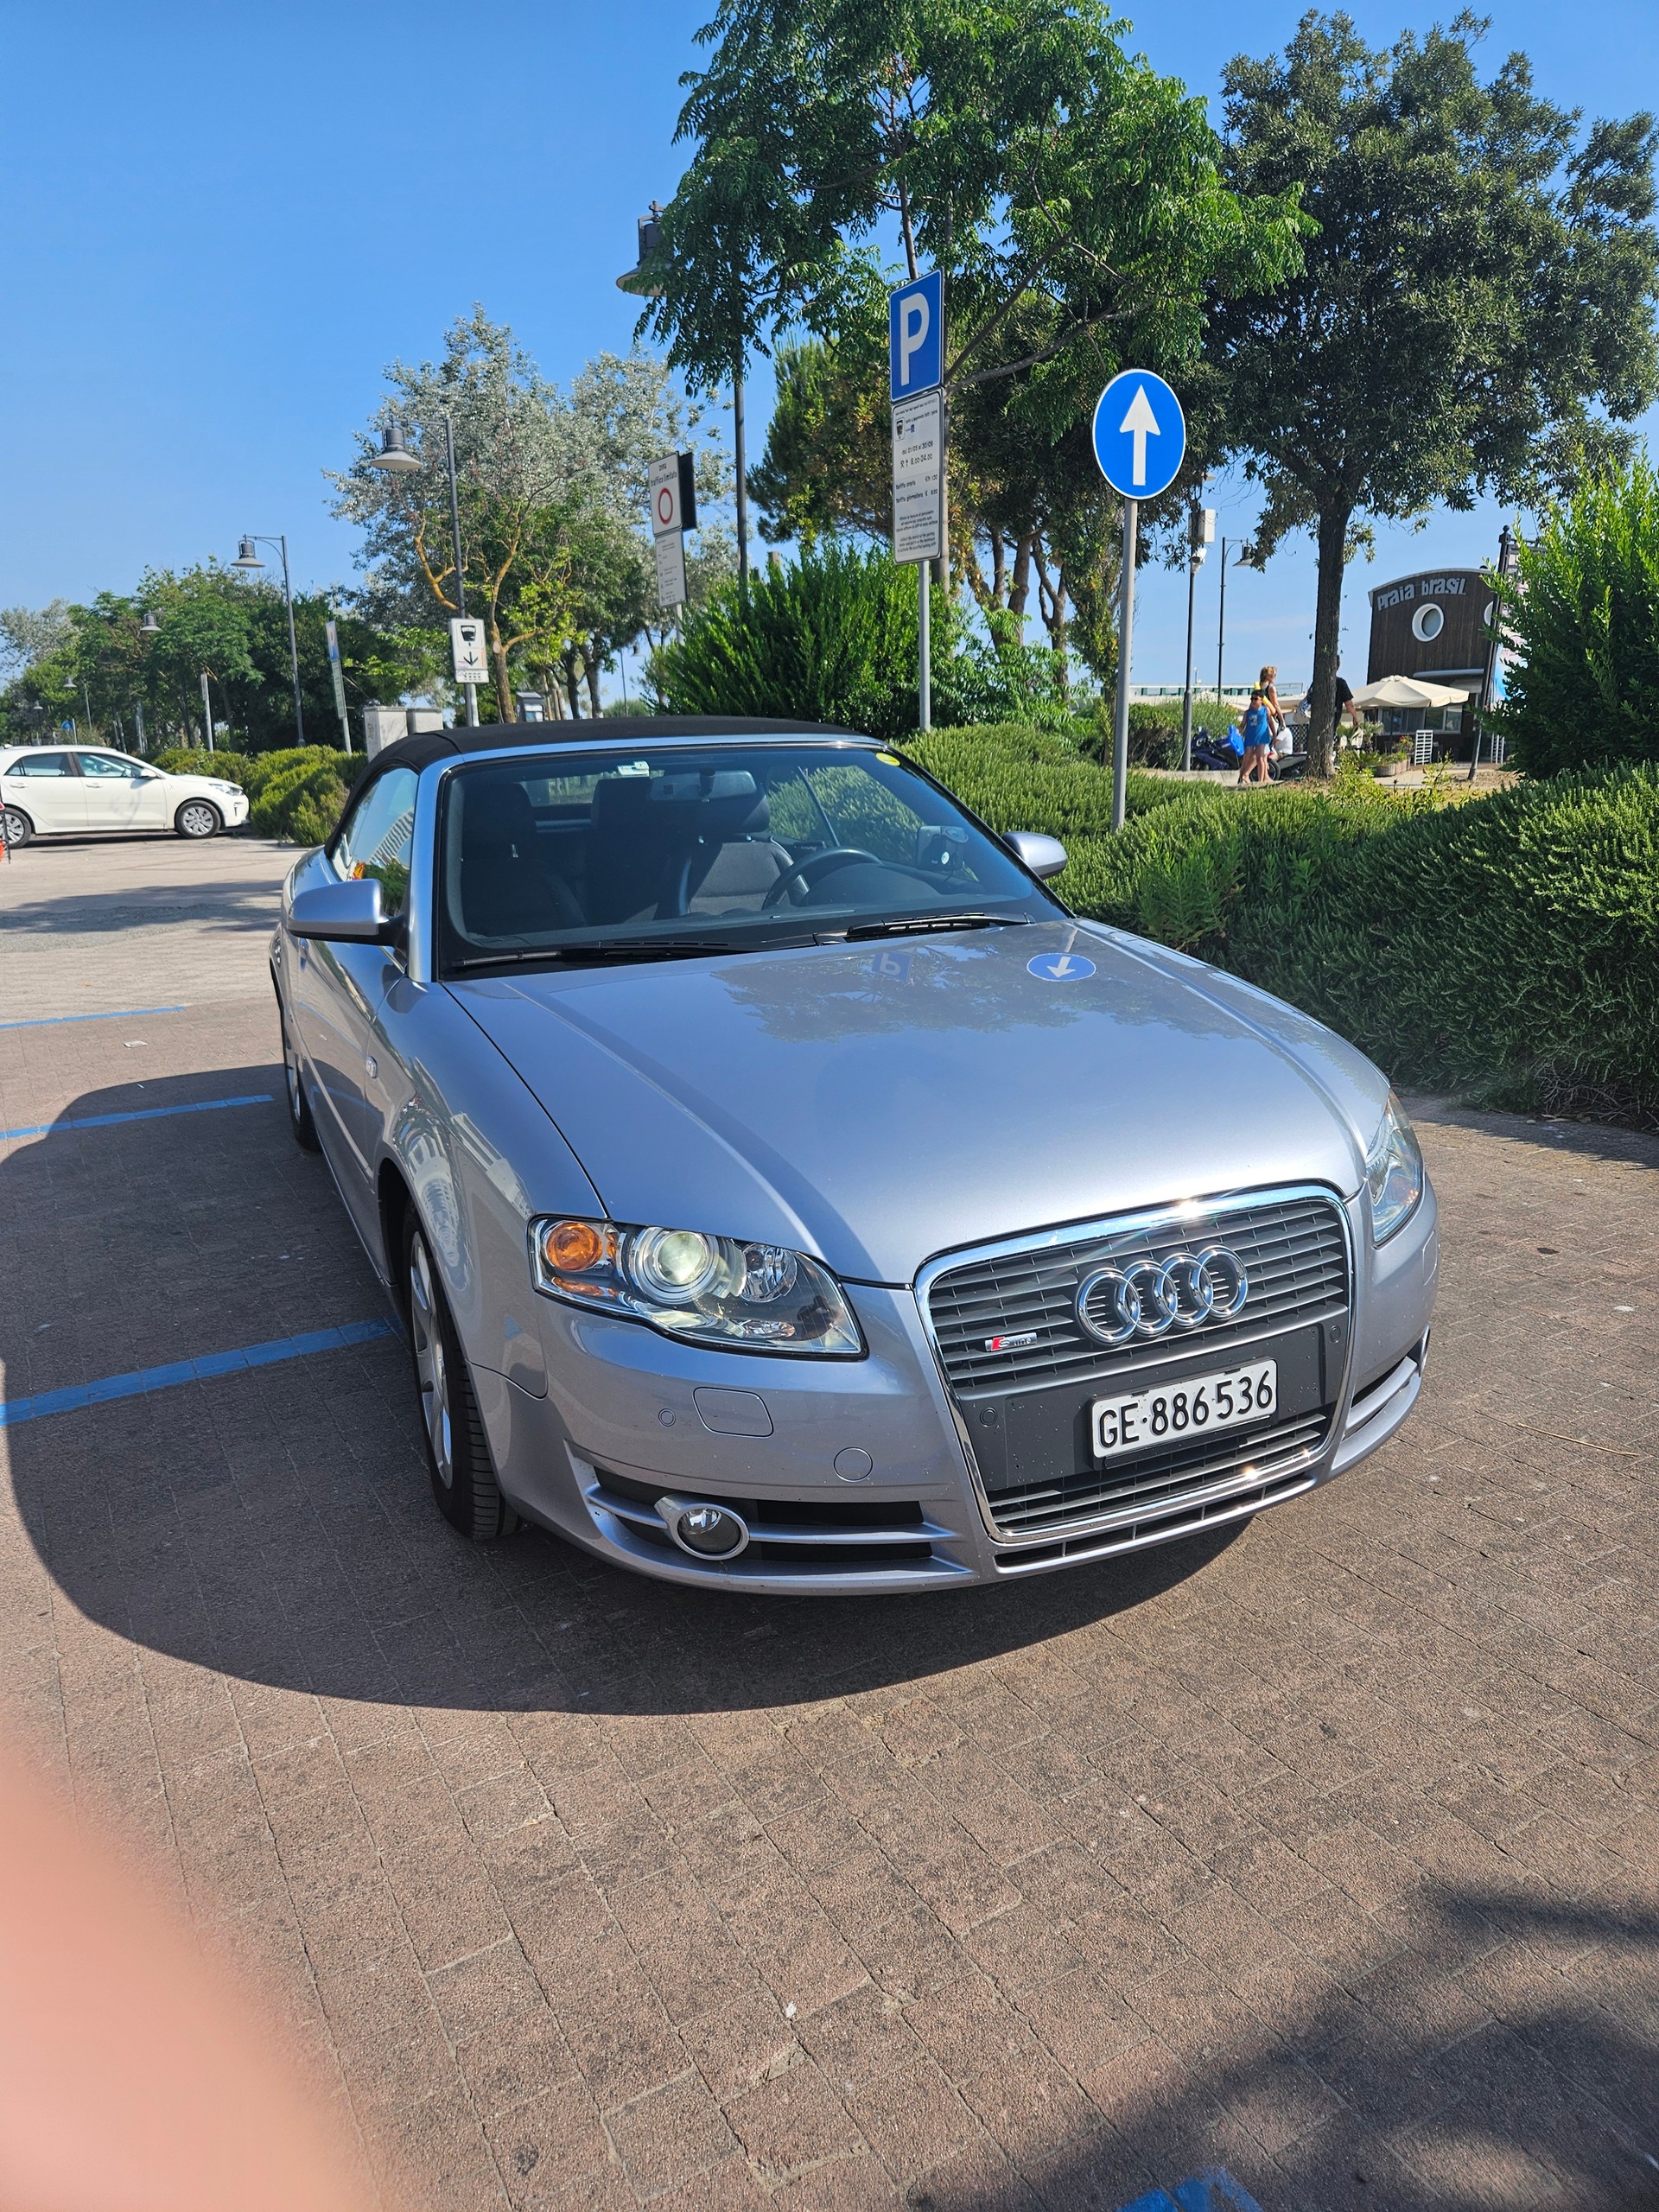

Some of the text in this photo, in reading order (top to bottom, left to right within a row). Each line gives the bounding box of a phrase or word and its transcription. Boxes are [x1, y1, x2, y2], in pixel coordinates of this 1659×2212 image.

[899, 292, 930, 387] P
[1377, 577, 1466, 611] praia brasil
